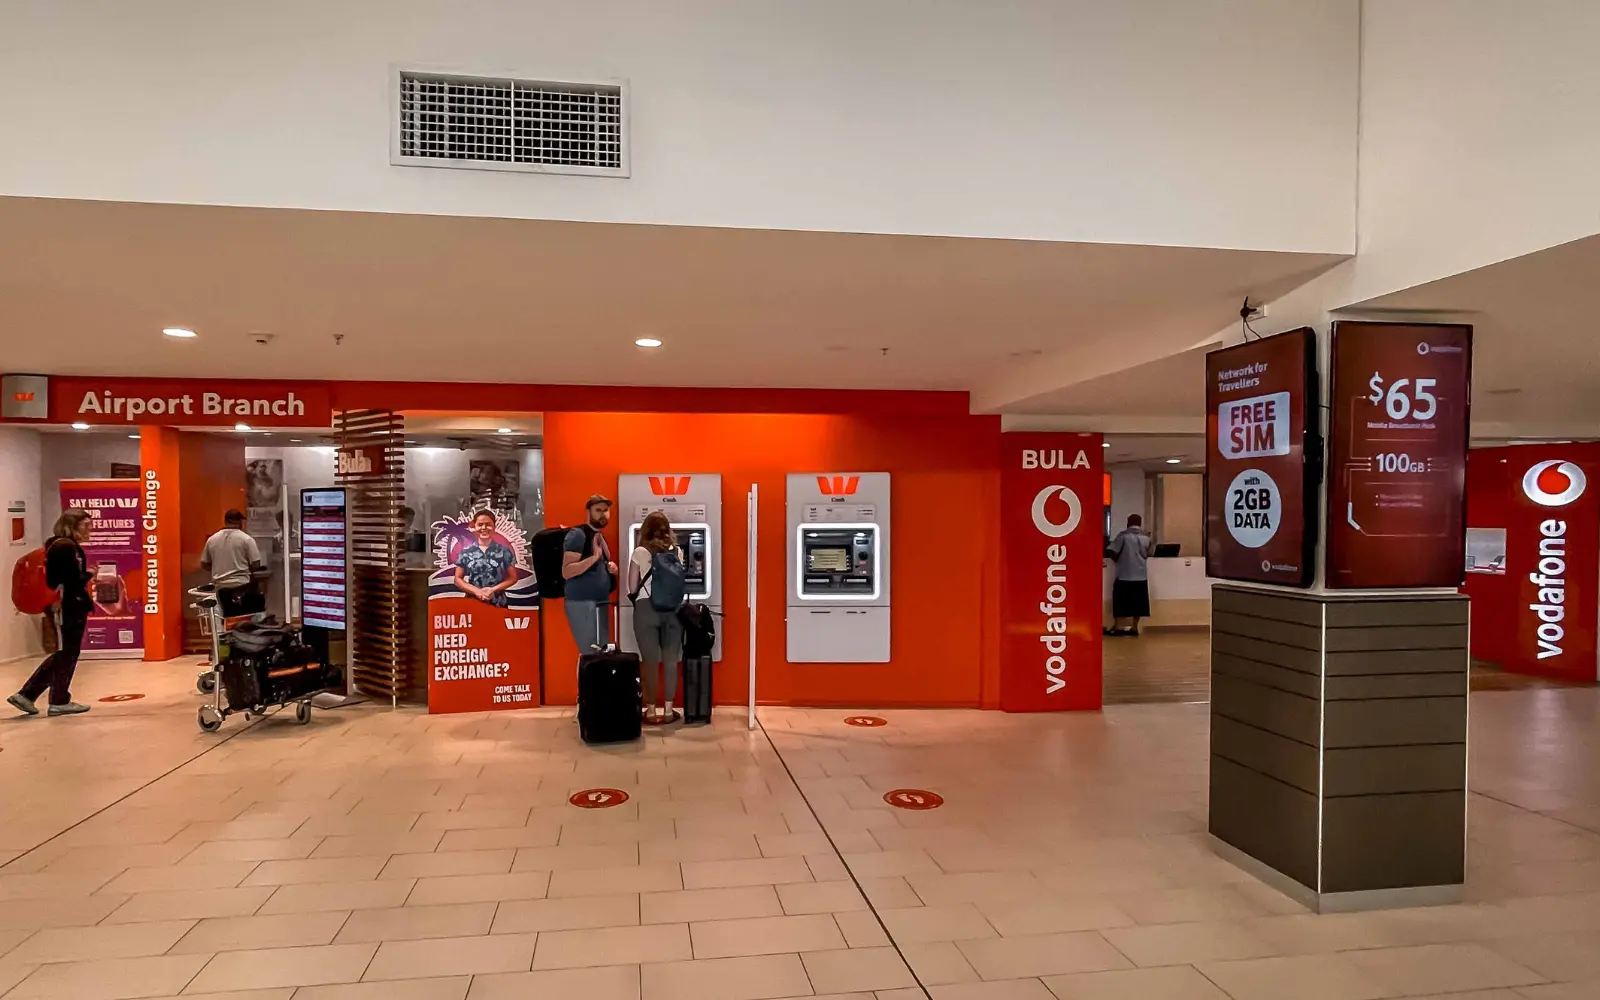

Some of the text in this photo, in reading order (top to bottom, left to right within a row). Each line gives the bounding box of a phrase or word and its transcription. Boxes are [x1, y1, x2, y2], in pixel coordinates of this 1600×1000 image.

[1218, 362, 1268, 380] Network for
[1218, 378, 1260, 392] Travellers
[78, 390, 305, 421] Airport Branch
[1368, 371, 1437, 421] $65
[1230, 400, 1277, 427] FREE
[1230, 422, 1275, 454] SIM
[338, 449, 372, 473] Bula
[1022, 449, 1091, 470] BULA
[1375, 453, 1425, 473] 100GB
[1244, 477, 1261, 486] with
[69, 498, 116, 508] SAY HELLO
[1233, 488, 1272, 511] 2GB
[92, 519, 135, 529] FEATURES
[1234, 512, 1271, 529] DATA
[142, 469, 160, 614] Bureau de Change
[1529, 519, 1567, 659] vodafone
[434, 613, 473, 630] BULA!
[1039, 544, 1067, 694] vodafone
[434, 633, 467, 649] NEED
[434, 648, 488, 665] FOREIGN
[434, 662, 510, 681] EXCHANGE?
[493, 693, 532, 703] TO US TODAY
[495, 684, 531, 694] COME TALK
